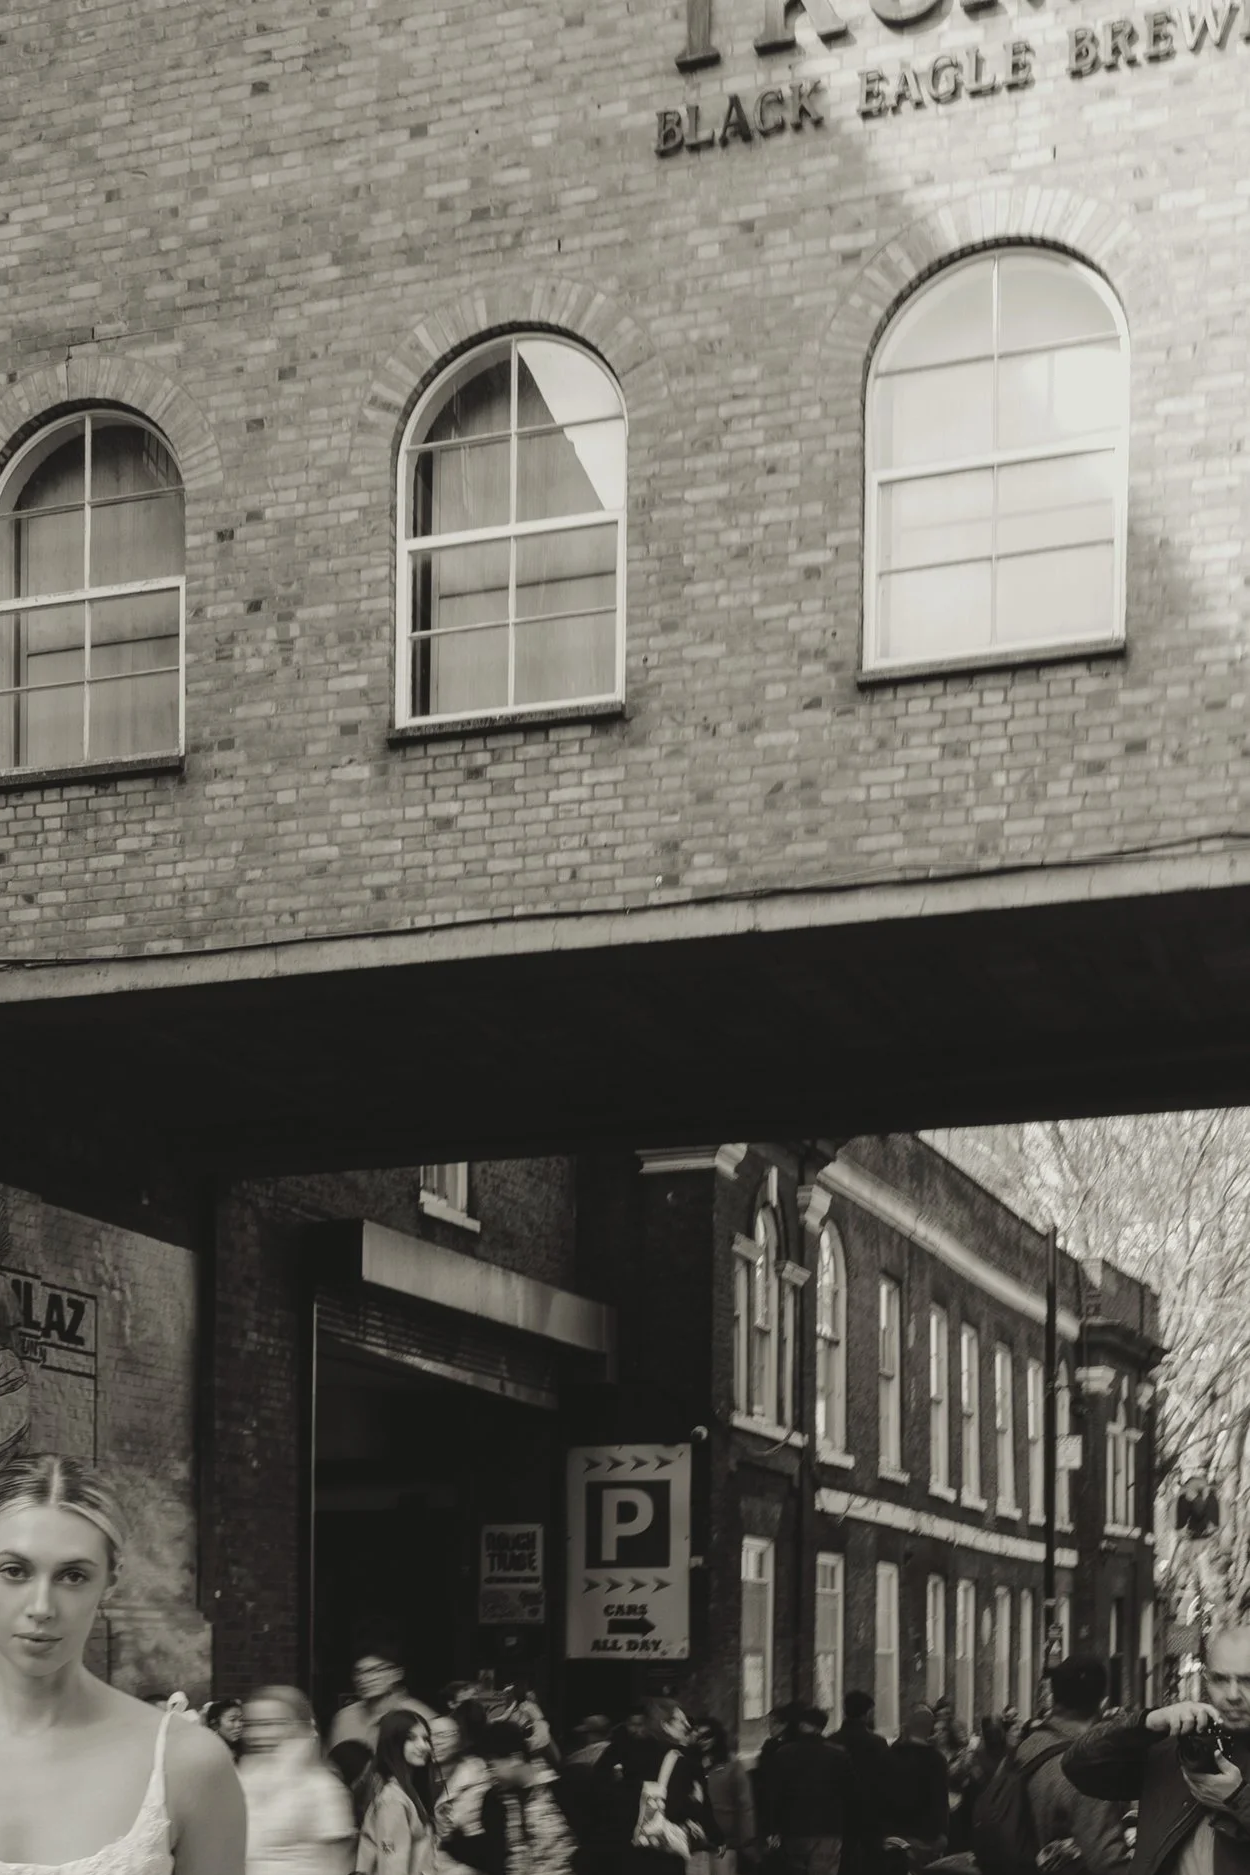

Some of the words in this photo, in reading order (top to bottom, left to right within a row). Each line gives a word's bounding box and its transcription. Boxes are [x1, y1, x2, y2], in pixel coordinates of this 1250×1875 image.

[655, 79, 825, 158] BLACK
[856, 40, 1036, 119] EAGLE
[1066, 0, 1250, 80] BREW
[602, 1488, 654, 1561] P
[603, 1604, 649, 1617] CARS
[590, 1639, 623, 1652] ALL
[625, 1639, 663, 1652] DAY
